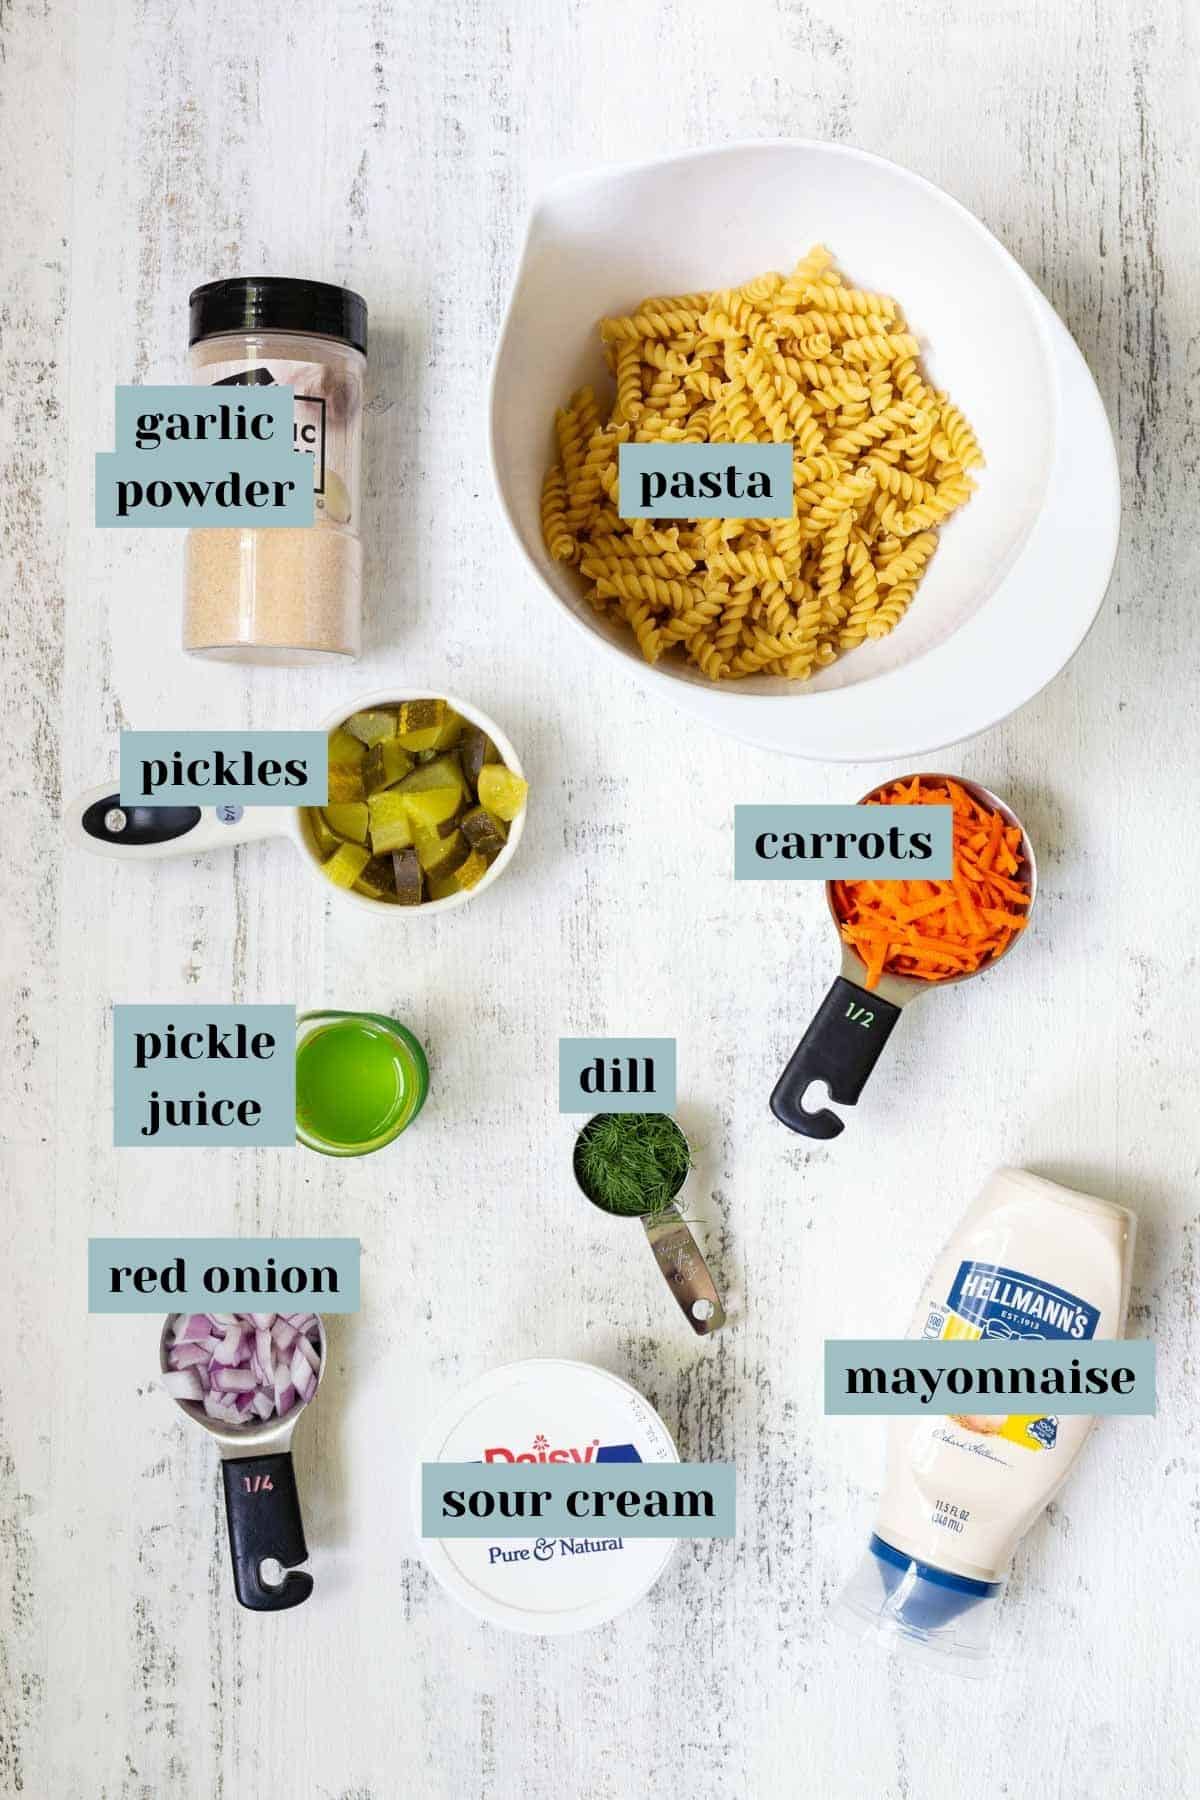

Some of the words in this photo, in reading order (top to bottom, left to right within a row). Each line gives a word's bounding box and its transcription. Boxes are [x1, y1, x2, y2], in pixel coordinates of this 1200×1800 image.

[846, 1002, 874, 1028] 1/2
[959, 1273, 1089, 1339] HELLMANN'S
[244, 1475, 273, 1493] 1/4
[950, 1504, 959, 1516] FL
[488, 1546, 530, 1564] Pure
[533, 1538, 557, 1561] &
[559, 1537, 624, 1556] Natural
